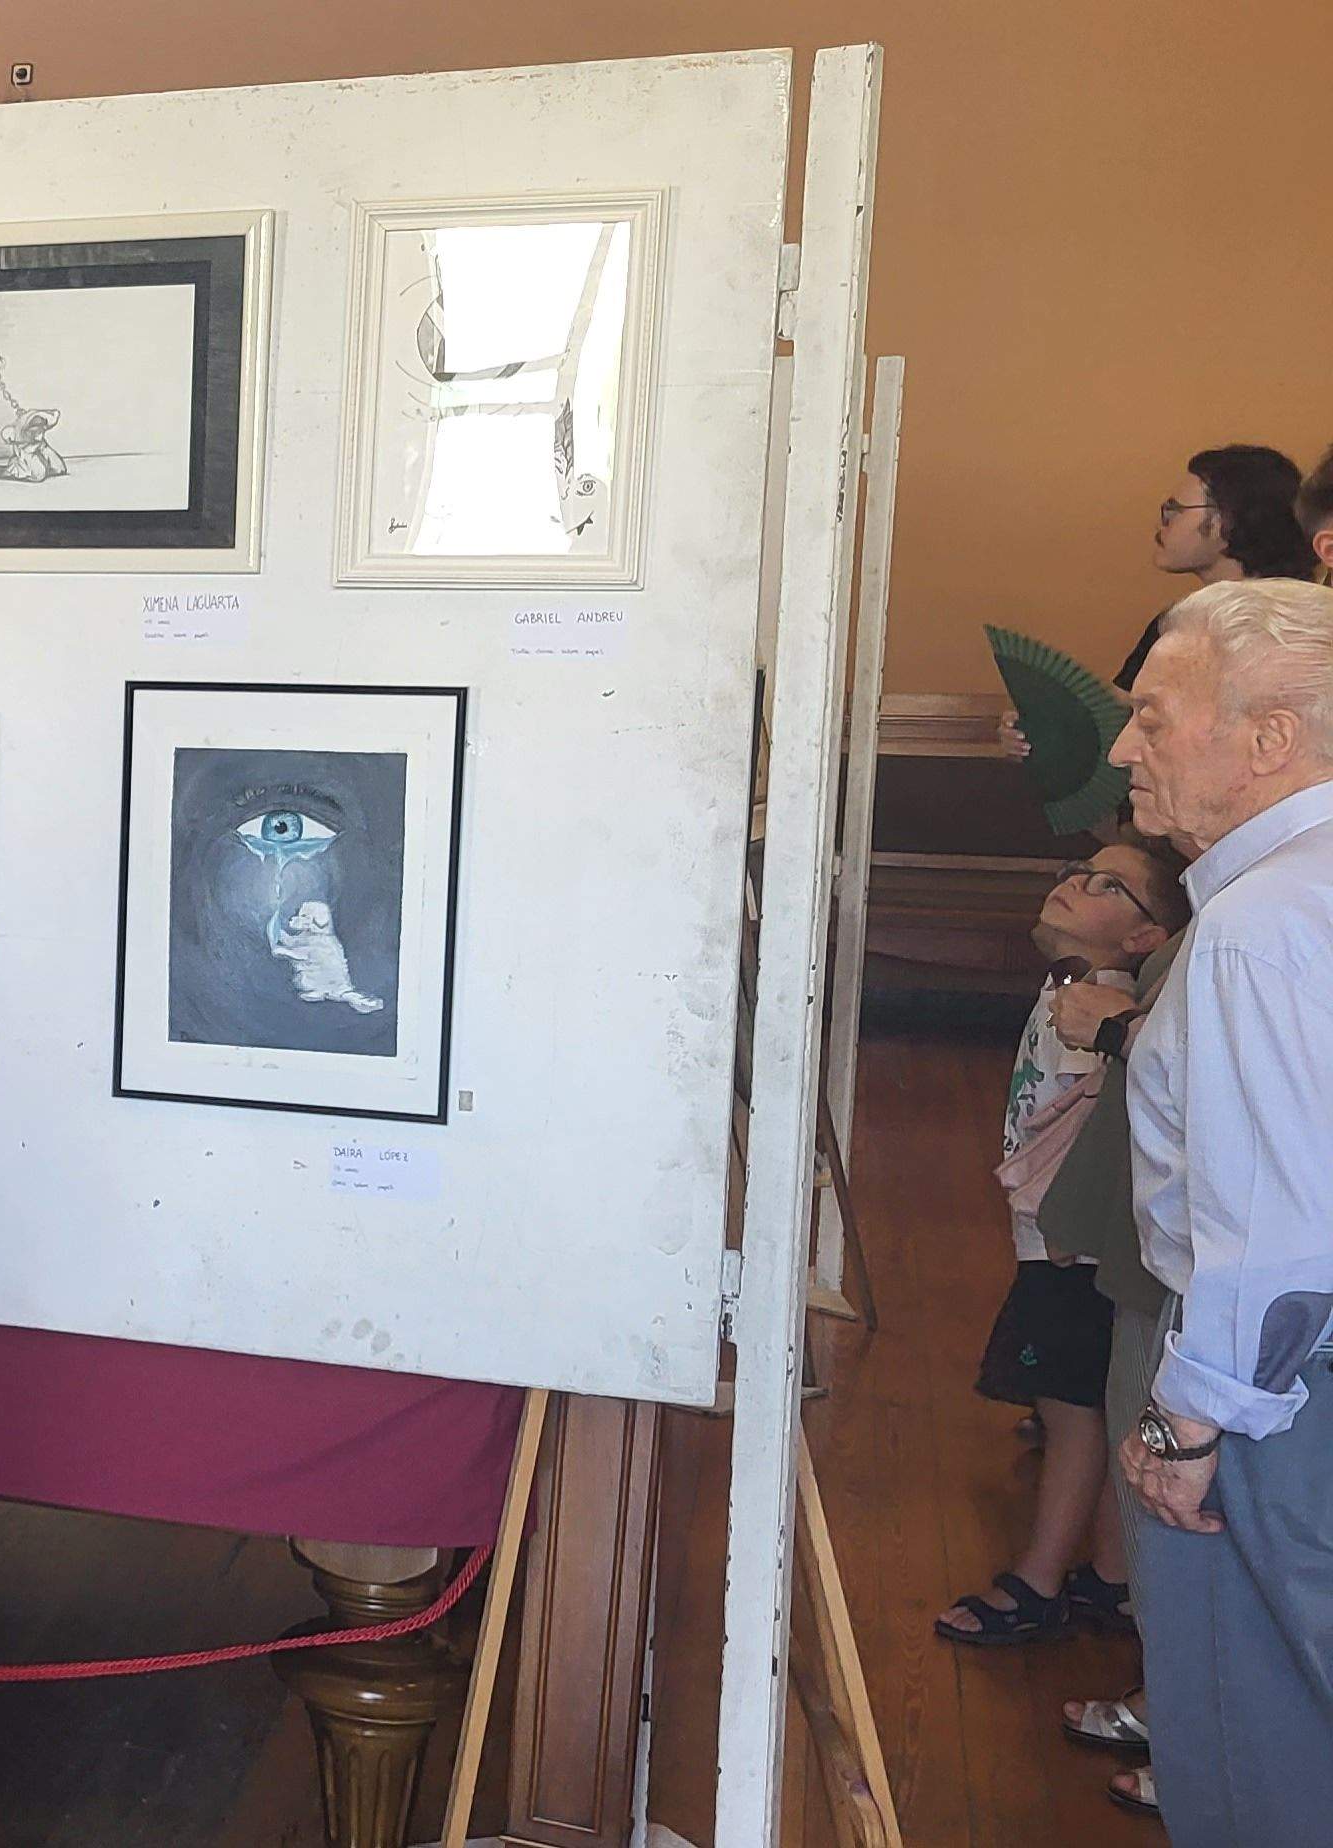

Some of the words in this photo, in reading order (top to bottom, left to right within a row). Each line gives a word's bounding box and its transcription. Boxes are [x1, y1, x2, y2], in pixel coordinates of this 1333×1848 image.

[143, 596, 179, 613] XIMENA
[186, 594, 240, 611] LAGUARTA
[514, 612, 561, 624] GABRIEL
[577, 611, 623, 623] ANDREU
[333, 1147, 363, 1159] DAIRA
